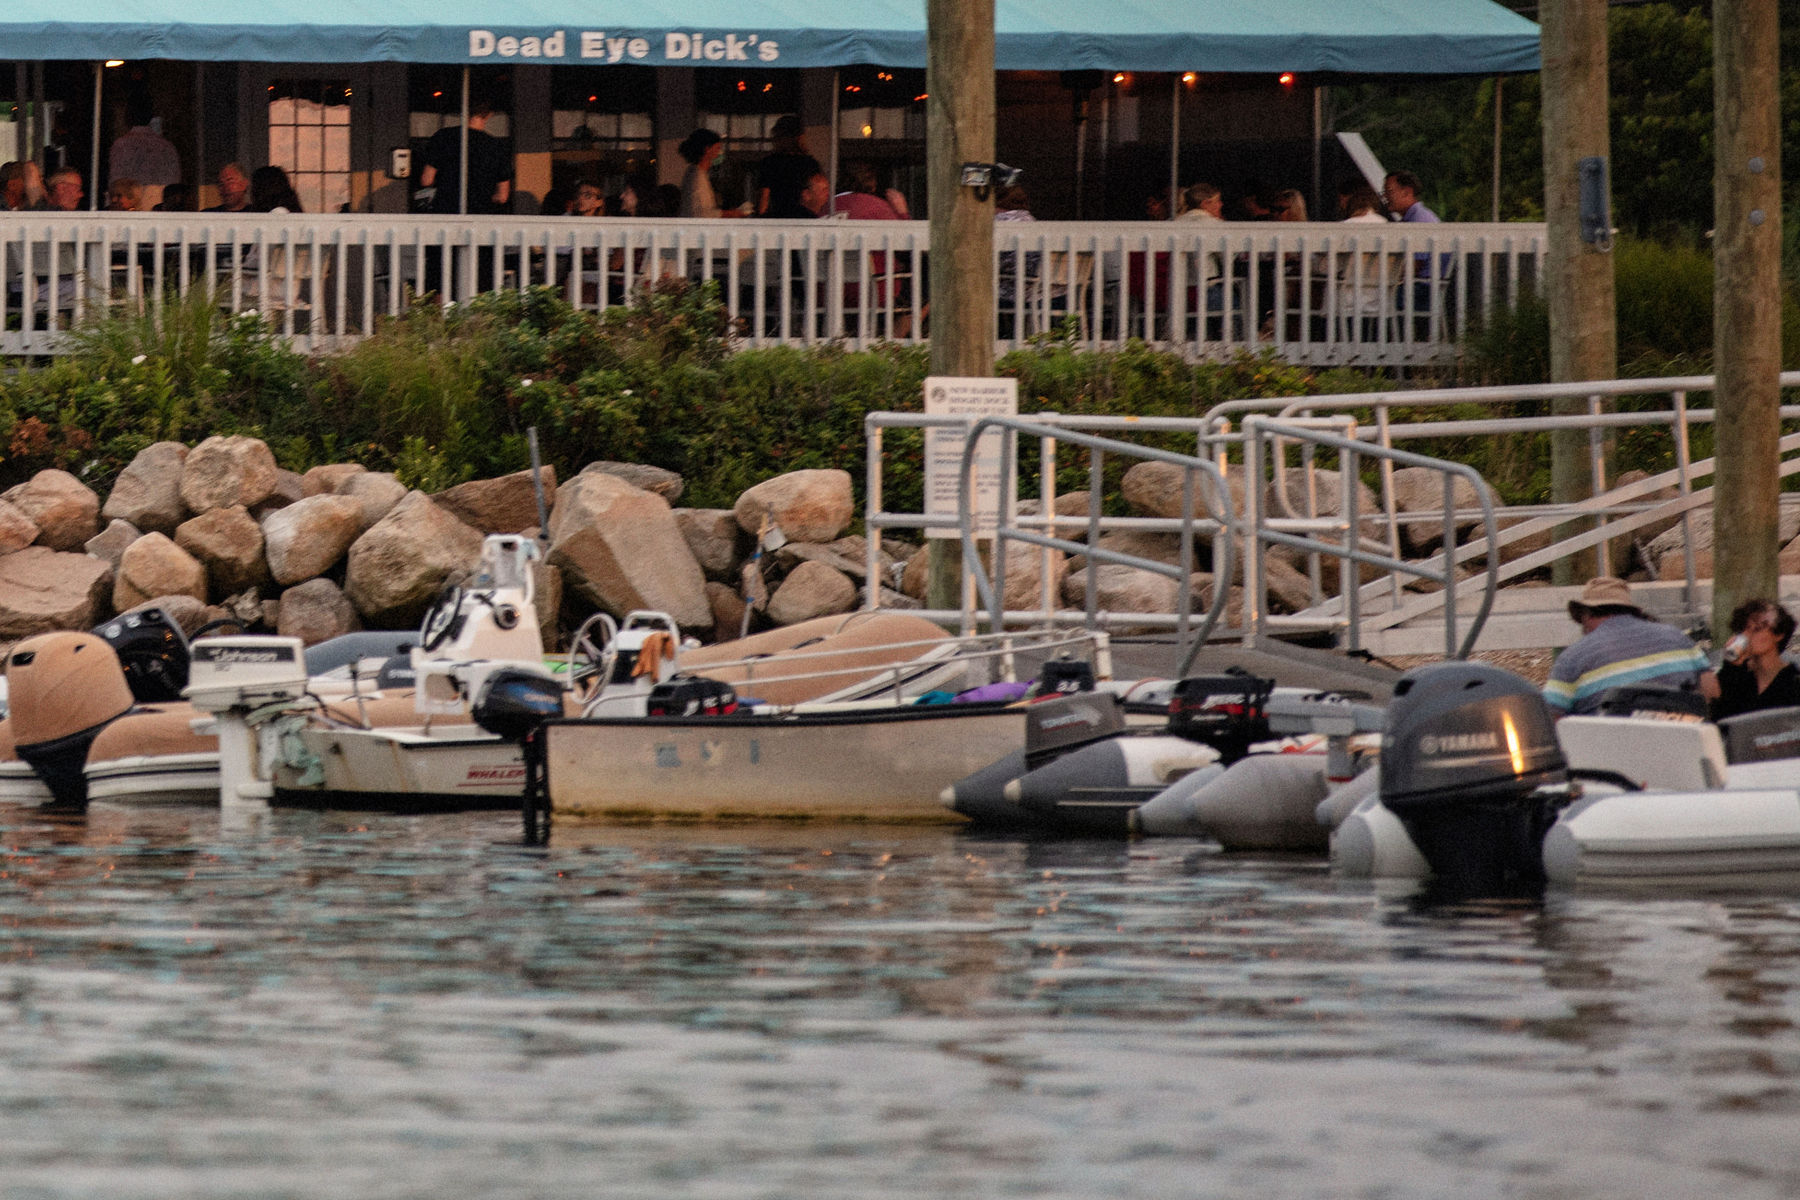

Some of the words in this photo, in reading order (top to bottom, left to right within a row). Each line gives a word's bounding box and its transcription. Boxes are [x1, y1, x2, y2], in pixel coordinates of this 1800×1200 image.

[469, 29, 565, 57] Dead
[580, 31, 649, 63] Eye
[664, 32, 779, 62] Dick's
